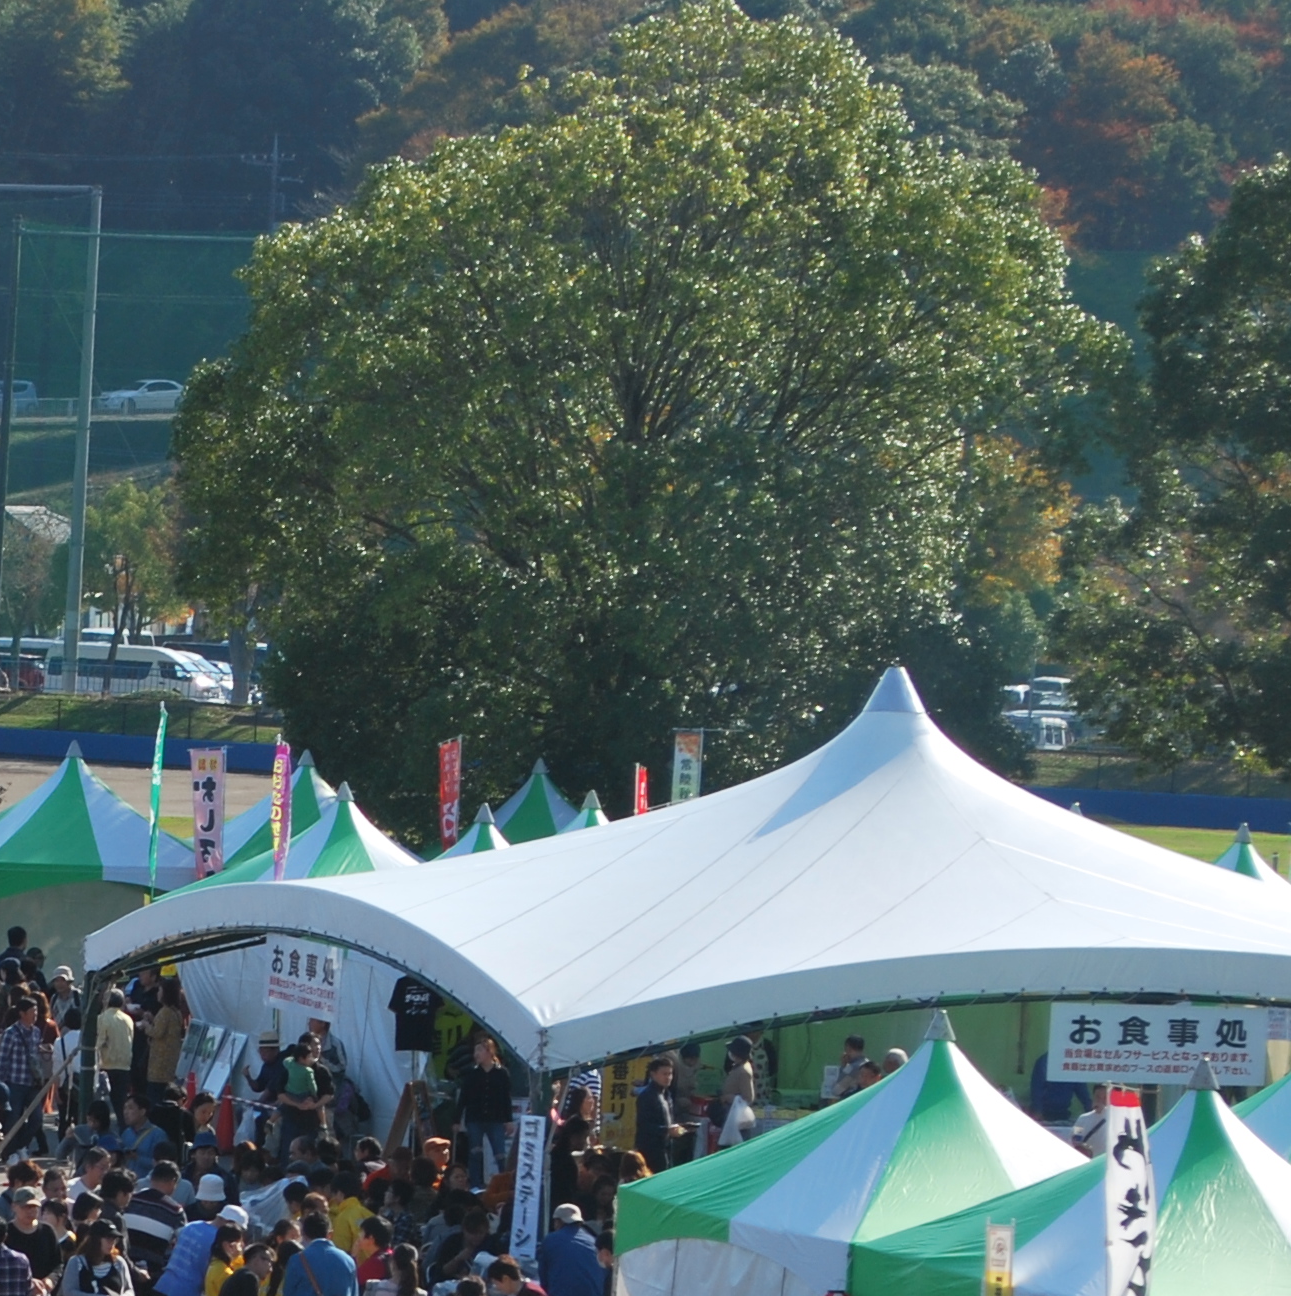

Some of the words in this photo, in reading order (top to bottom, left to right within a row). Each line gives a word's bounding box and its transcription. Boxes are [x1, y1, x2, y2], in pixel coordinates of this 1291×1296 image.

[271, 944, 335, 987] お食事処
[1069, 1009, 1248, 1048] お食事処
